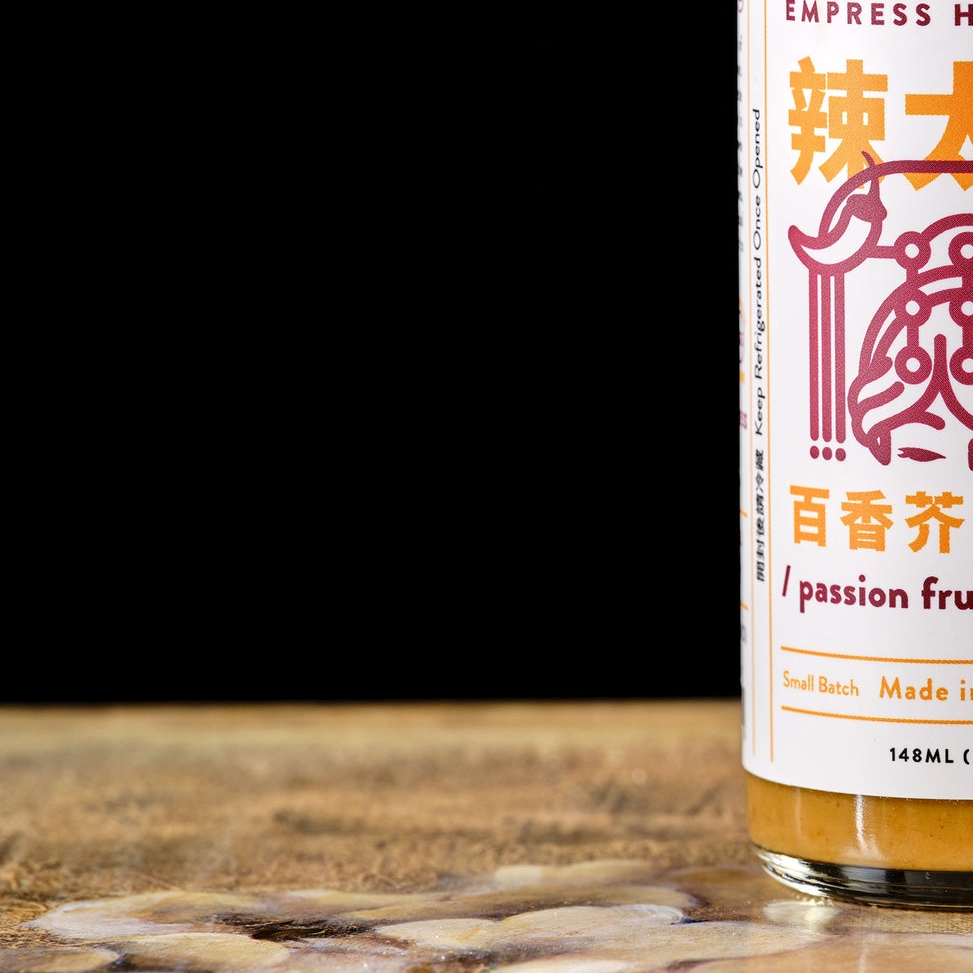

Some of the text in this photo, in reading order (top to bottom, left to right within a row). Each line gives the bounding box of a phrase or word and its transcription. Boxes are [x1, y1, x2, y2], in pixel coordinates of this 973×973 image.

[752, 108, 766, 436] Keep Refrigerated Once Opened
[799, 575, 909, 613] passion
[783, 670, 860, 697] Small Batch
[879, 675, 949, 702] Made
[889, 747, 955, 764] 148ML
